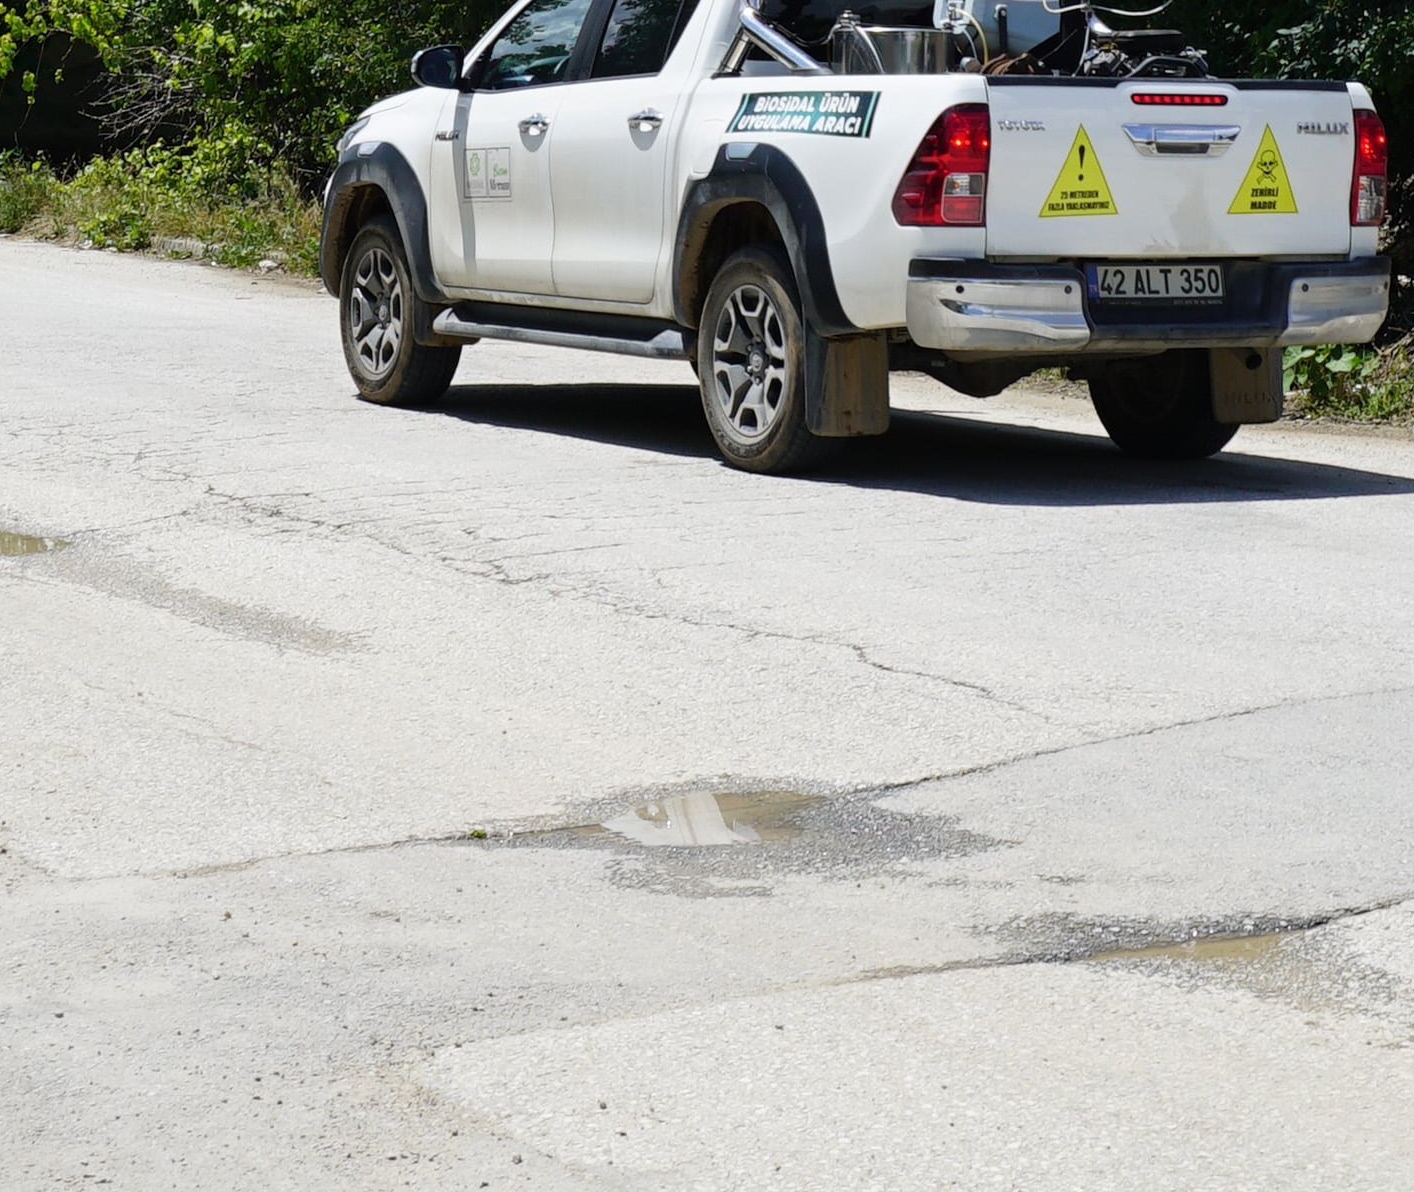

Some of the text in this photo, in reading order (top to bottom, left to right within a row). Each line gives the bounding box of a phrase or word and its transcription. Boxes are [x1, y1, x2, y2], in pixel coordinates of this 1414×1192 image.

[754, 92, 861, 114] BİOSİDAL ÜRÜN
[737, 113, 862, 135] UYGULAMA ARACI
[1296, 122, 1350, 135] HILUX
[1100, 268, 1220, 295] 42 ALT 350
